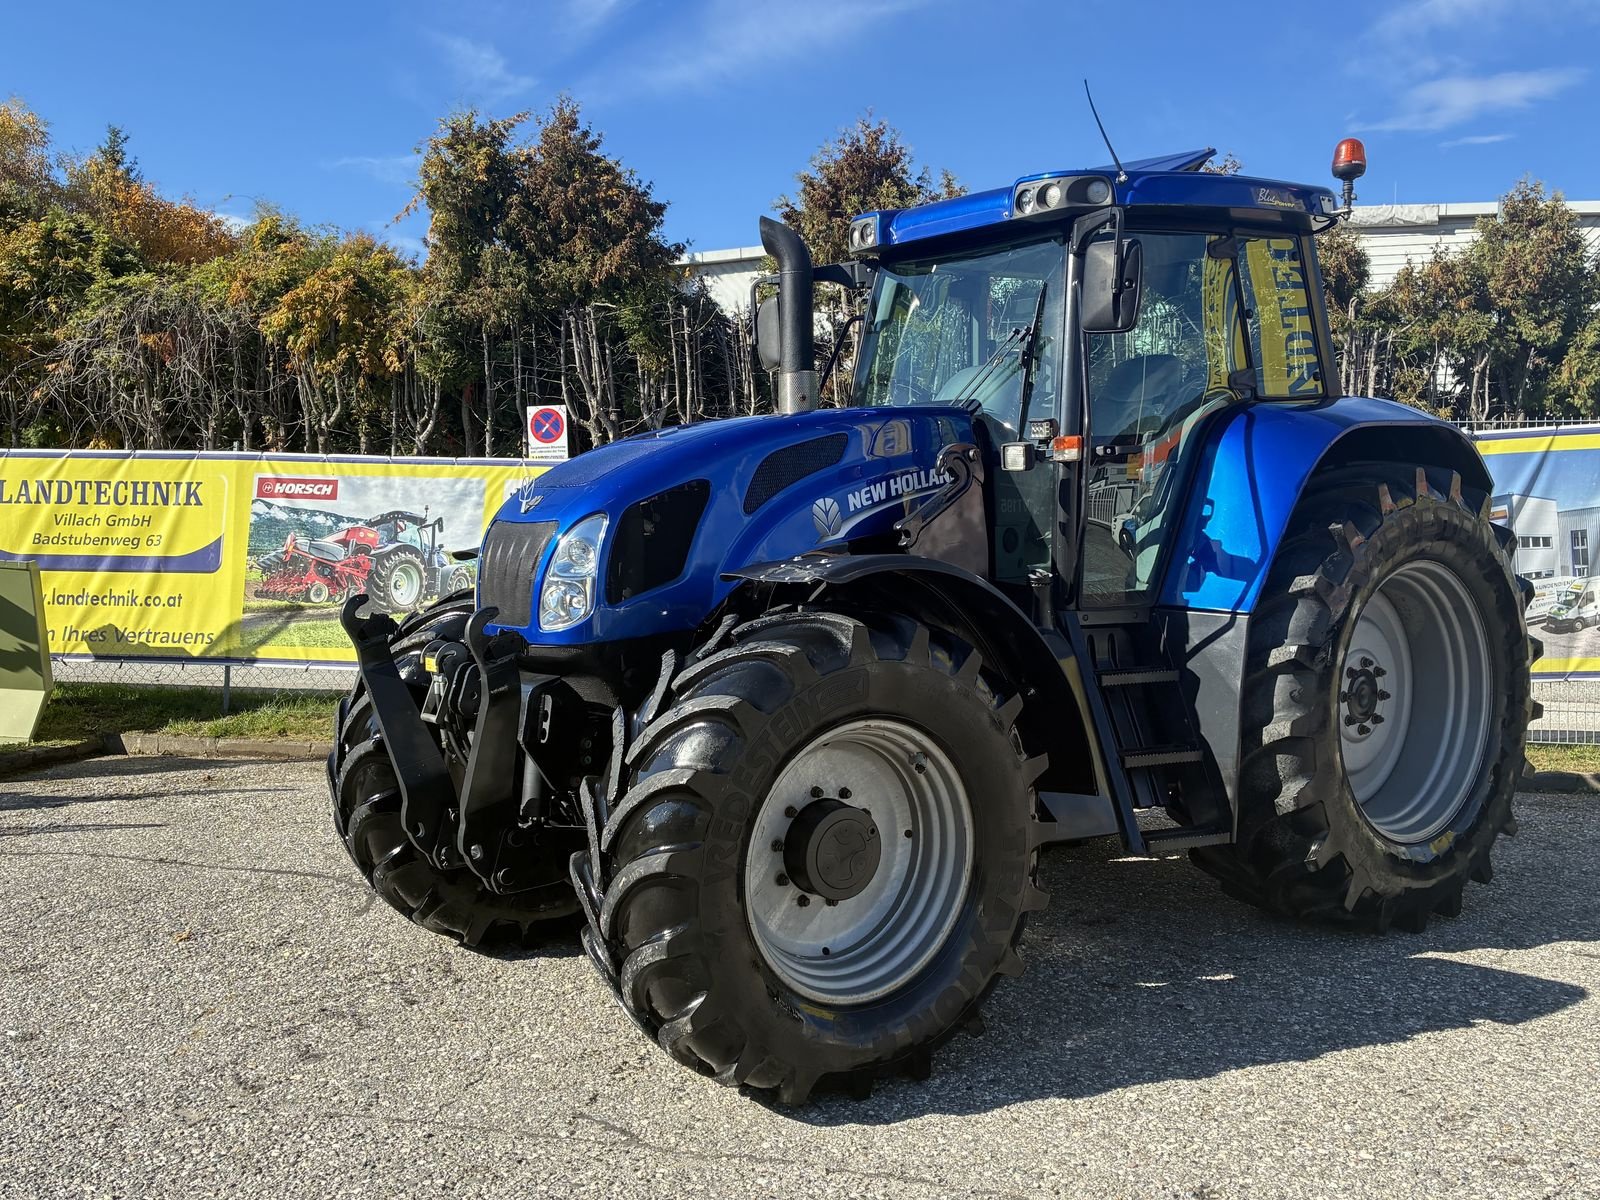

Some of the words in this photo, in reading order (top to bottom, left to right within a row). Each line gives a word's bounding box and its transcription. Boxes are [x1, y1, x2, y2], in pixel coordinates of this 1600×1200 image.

[0, 479, 203, 507] LANDTECHNIK
[274, 482, 334, 496] HORSCH
[847, 481, 887, 512] NEW
[889, 468, 954, 497] HOLLAN
[54, 513, 101, 527] Villach
[106, 514, 152, 528] GmbH
[32, 532, 141, 550] Badstubenweg
[146, 535, 162, 547] 63
[62, 625, 107, 643] Ihres
[114, 626, 214, 646] Vertrauens
[703, 689, 824, 887] VREDESTEIN
